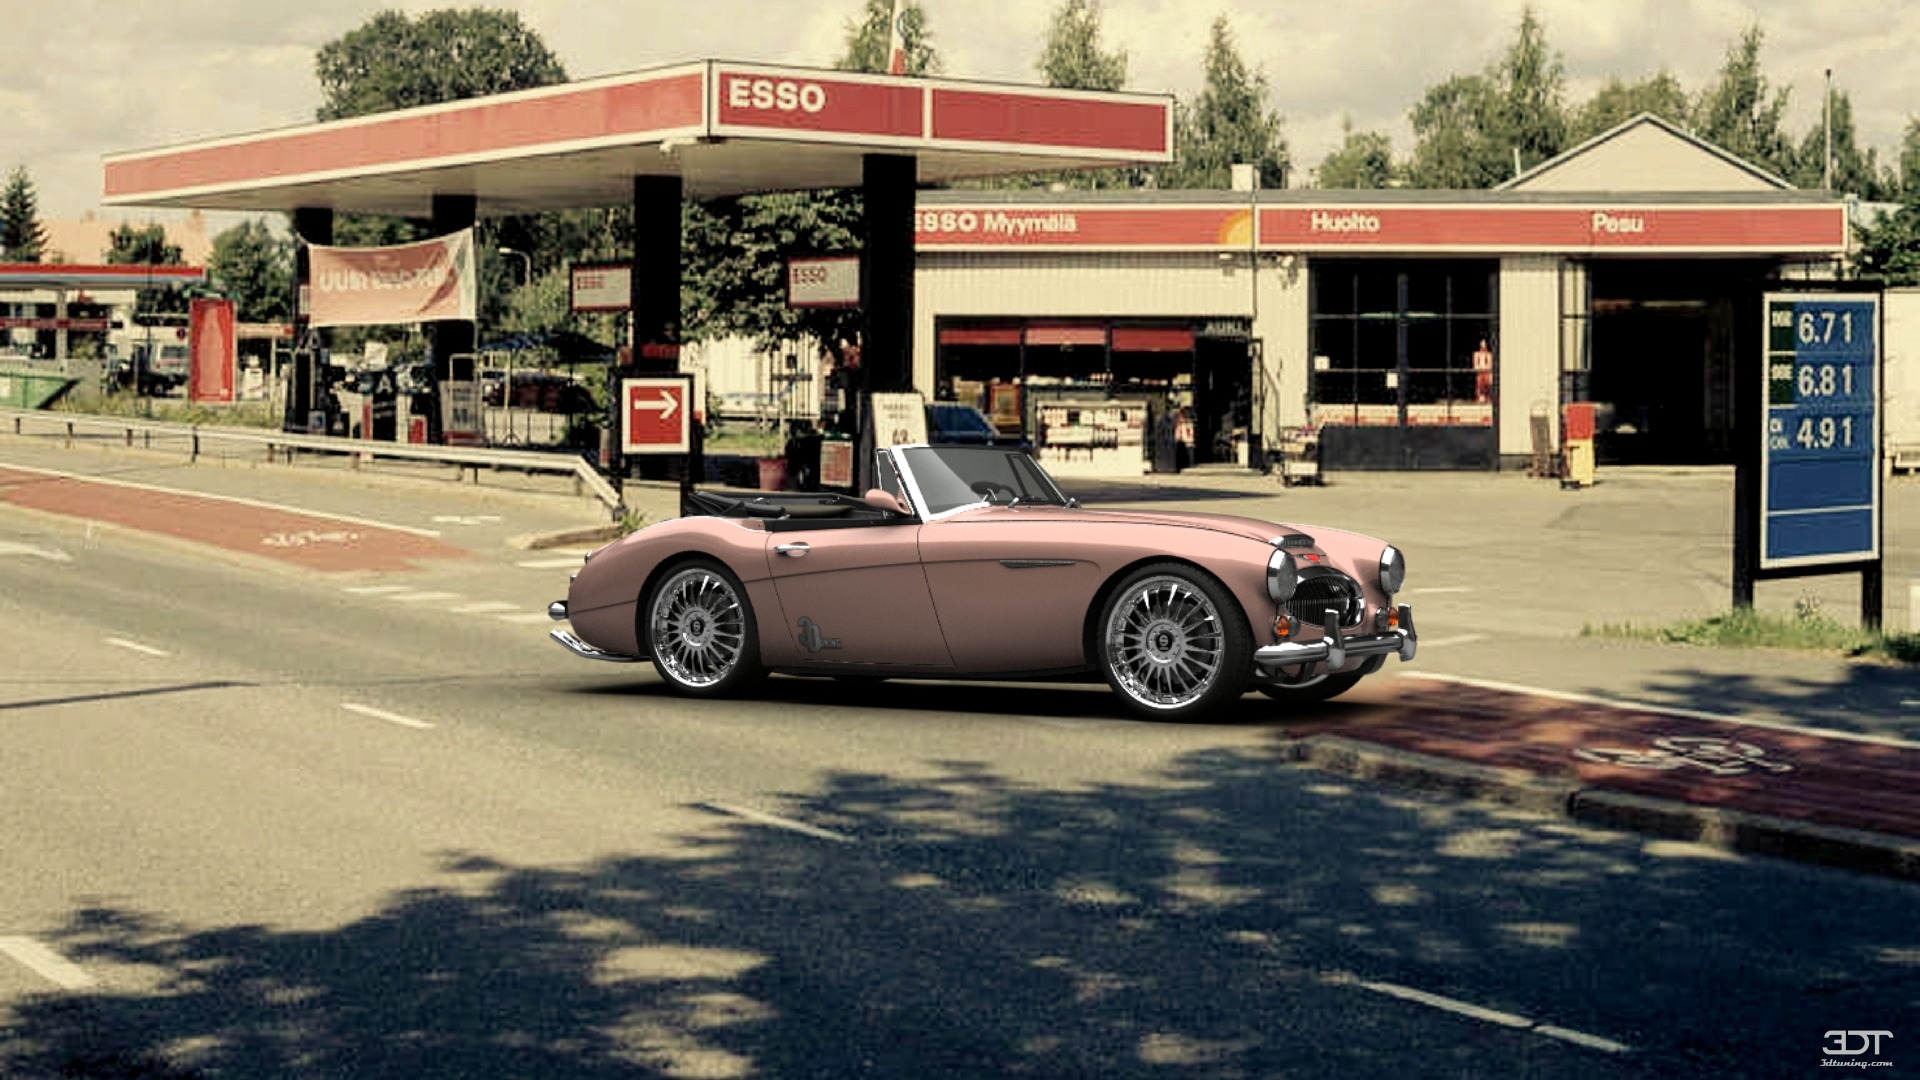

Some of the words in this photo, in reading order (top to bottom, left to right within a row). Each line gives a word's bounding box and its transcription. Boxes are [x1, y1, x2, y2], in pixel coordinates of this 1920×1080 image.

[728, 78, 826, 113] ESSO
[1311, 210, 1380, 232] Huolto
[1592, 213, 1644, 232] Pesu
[1799, 311, 1852, 344] 6.71
[1799, 364, 1852, 397] 6.81
[1796, 416, 1852, 448] 4.91
